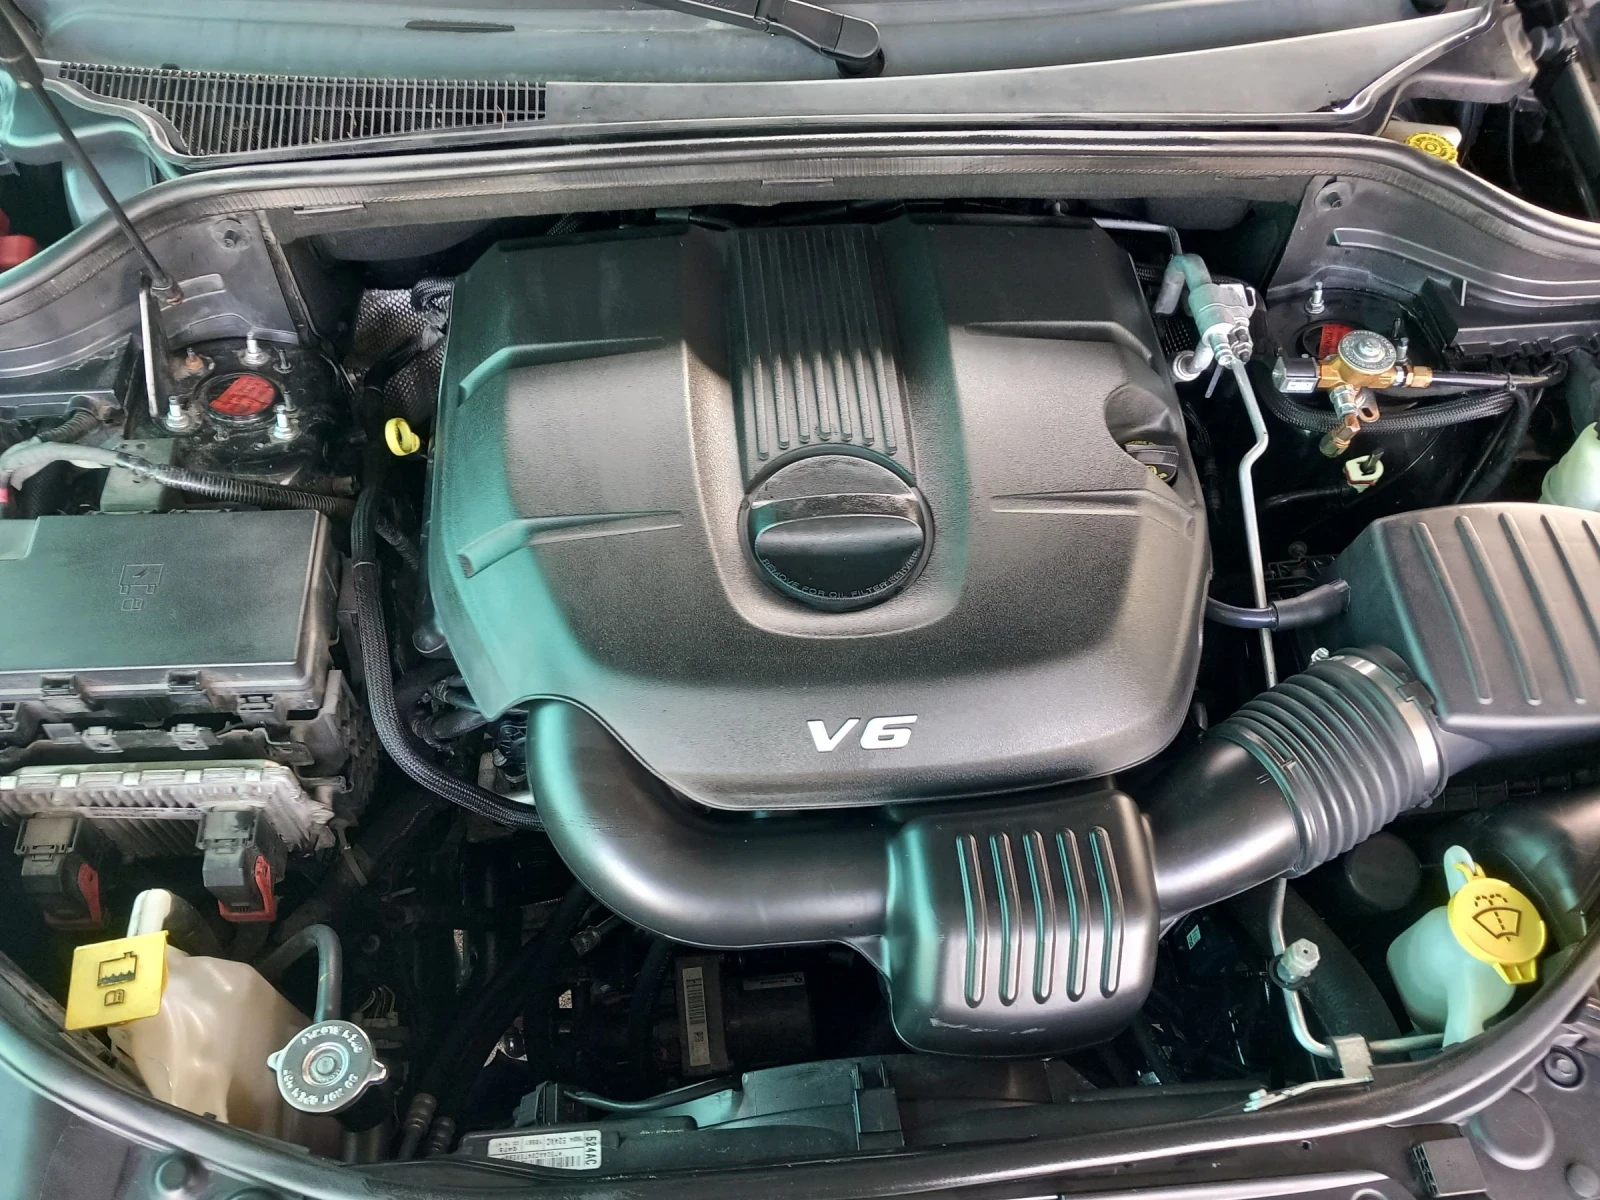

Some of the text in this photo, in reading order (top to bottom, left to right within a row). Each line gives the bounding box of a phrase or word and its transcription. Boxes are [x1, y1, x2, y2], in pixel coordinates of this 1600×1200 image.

[762, 558, 800, 589] REMOVE
[801, 585, 825, 596] FOR
[851, 581, 887, 597] FILTER
[807, 714, 918, 753] V6
[585, 1136, 597, 1166] 524AC
